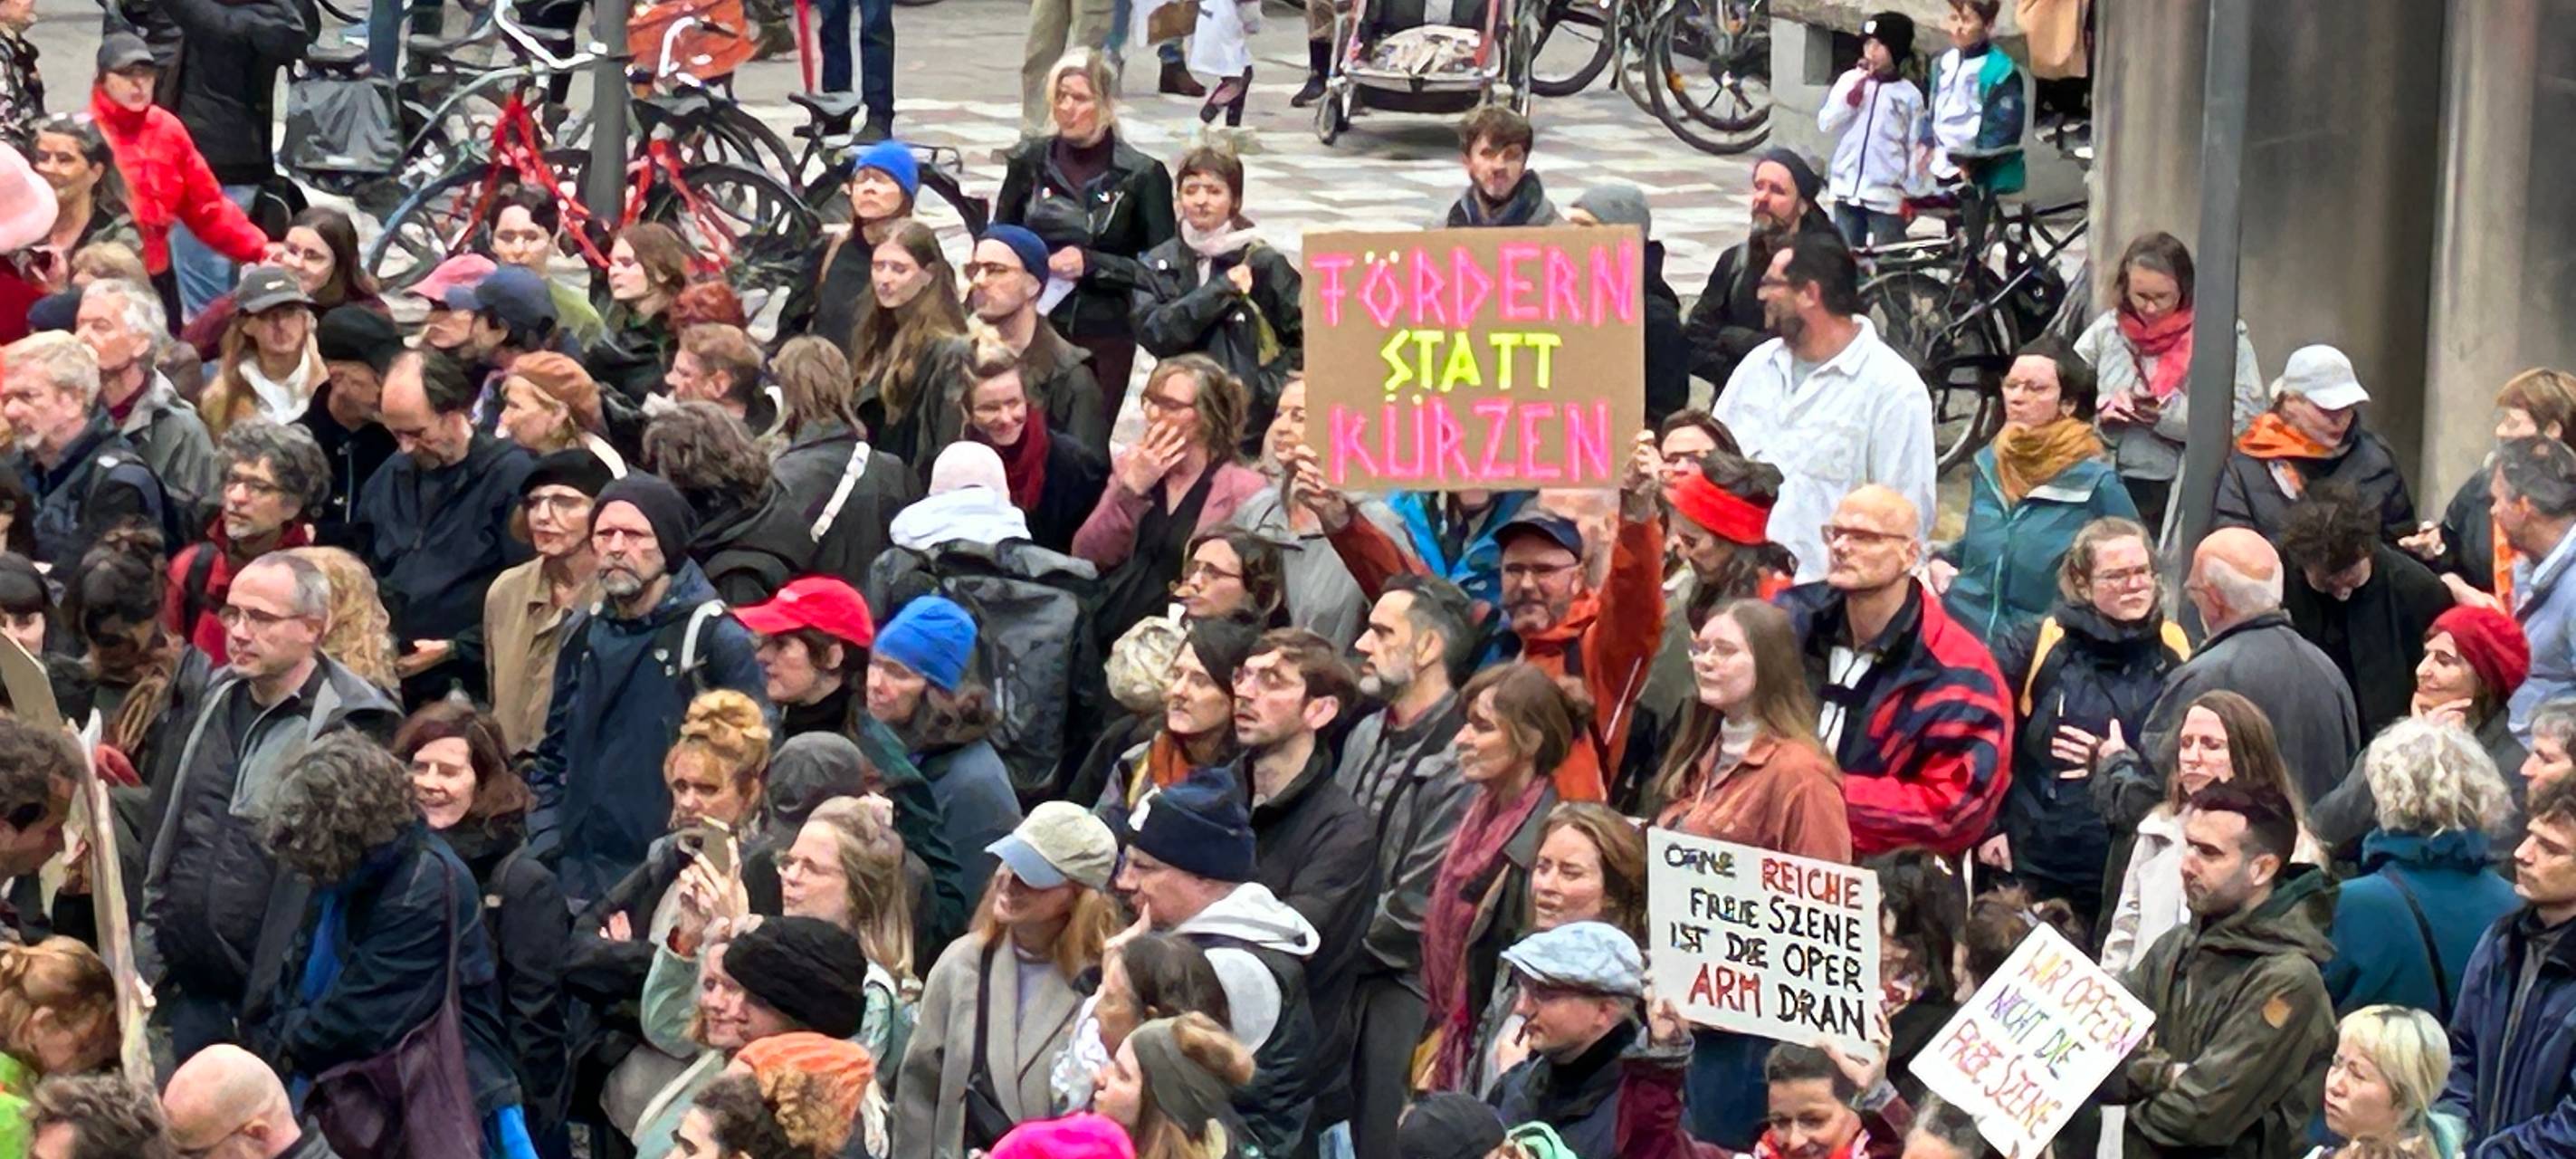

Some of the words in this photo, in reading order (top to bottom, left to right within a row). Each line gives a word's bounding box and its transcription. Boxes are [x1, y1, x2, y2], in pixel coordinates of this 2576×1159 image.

[1380, 328, 1563, 392] STATT
[1329, 393, 1614, 486] KÜRZEN
[1760, 857, 1864, 911] REICHE
[1670, 921, 1710, 954] IST
[1724, 931, 1770, 970] DIE
[1782, 942, 1865, 994] OPER
[1767, 896, 1864, 953] SZENE
[1687, 963, 1762, 1019] ARM
[1775, 983, 1867, 1042] DRAN
